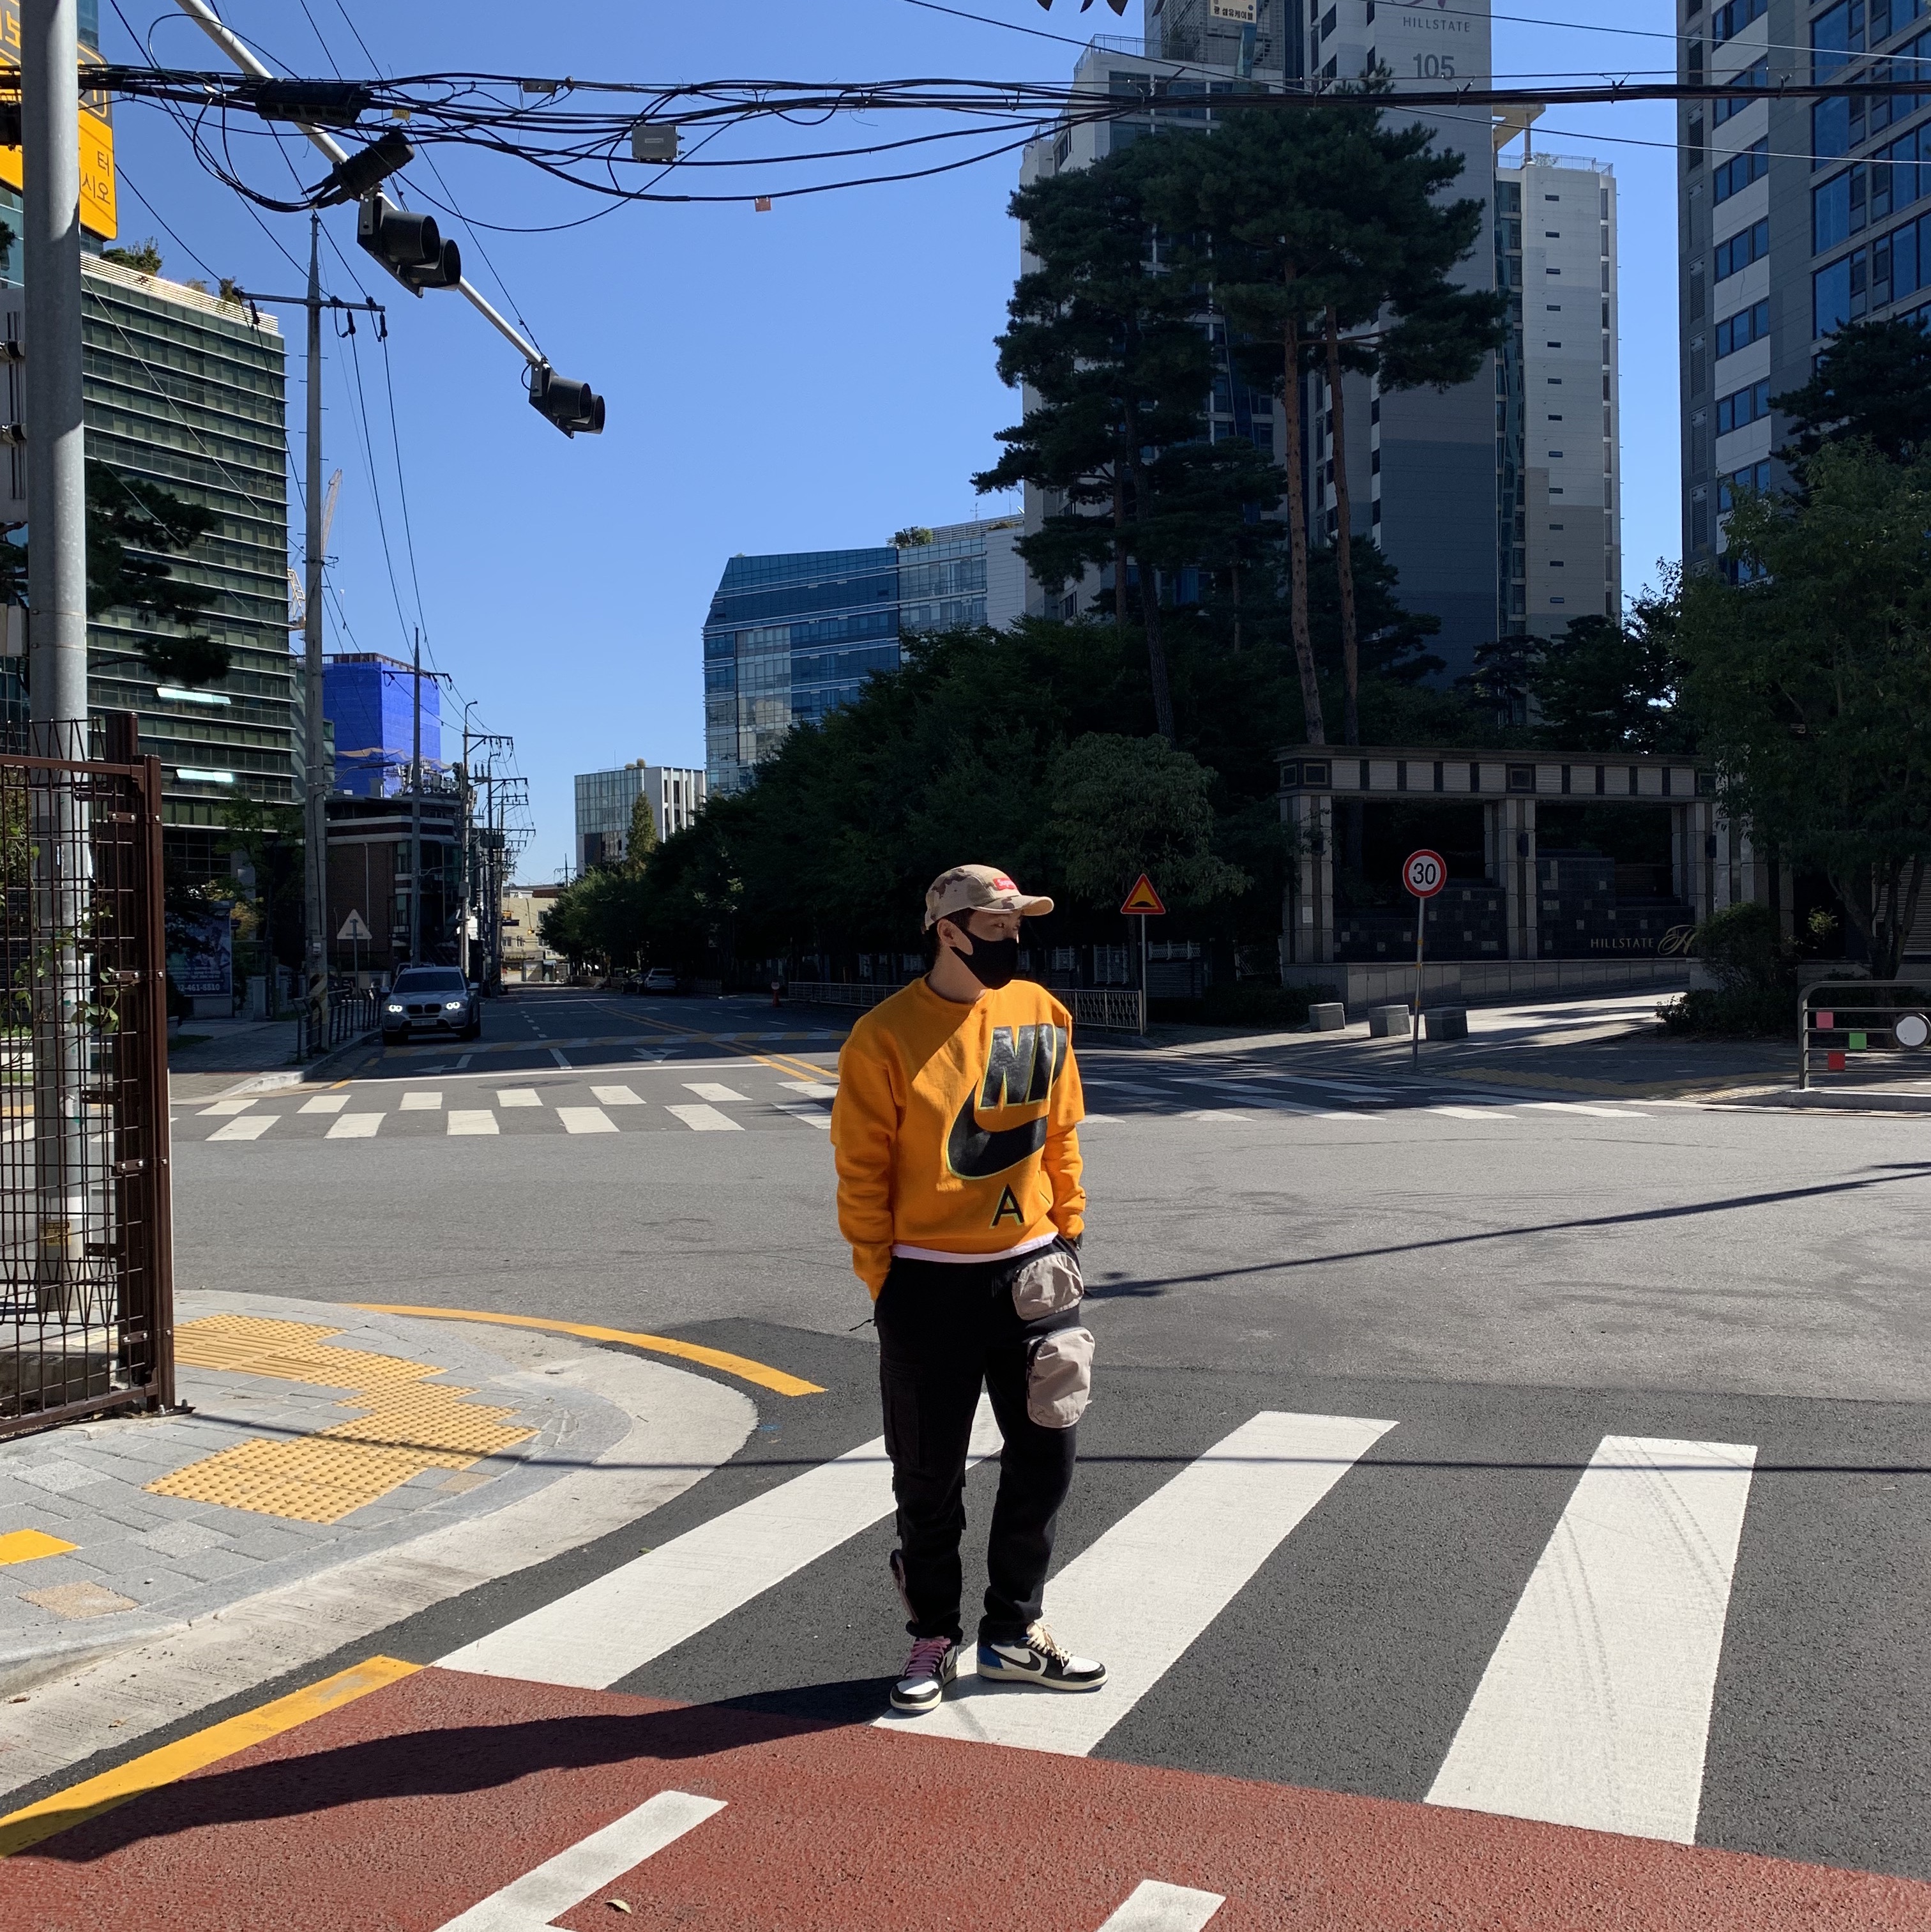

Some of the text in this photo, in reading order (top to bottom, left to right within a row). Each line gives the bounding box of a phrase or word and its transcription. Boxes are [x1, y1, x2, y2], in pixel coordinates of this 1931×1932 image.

[1402, 16, 1471, 33] HILLSTATE
[1412, 53, 1455, 81] 105
[81, 172, 110, 205] 시오
[1413, 862, 1436, 885] 30
[1590, 938, 1654, 949] HILLSTATE
